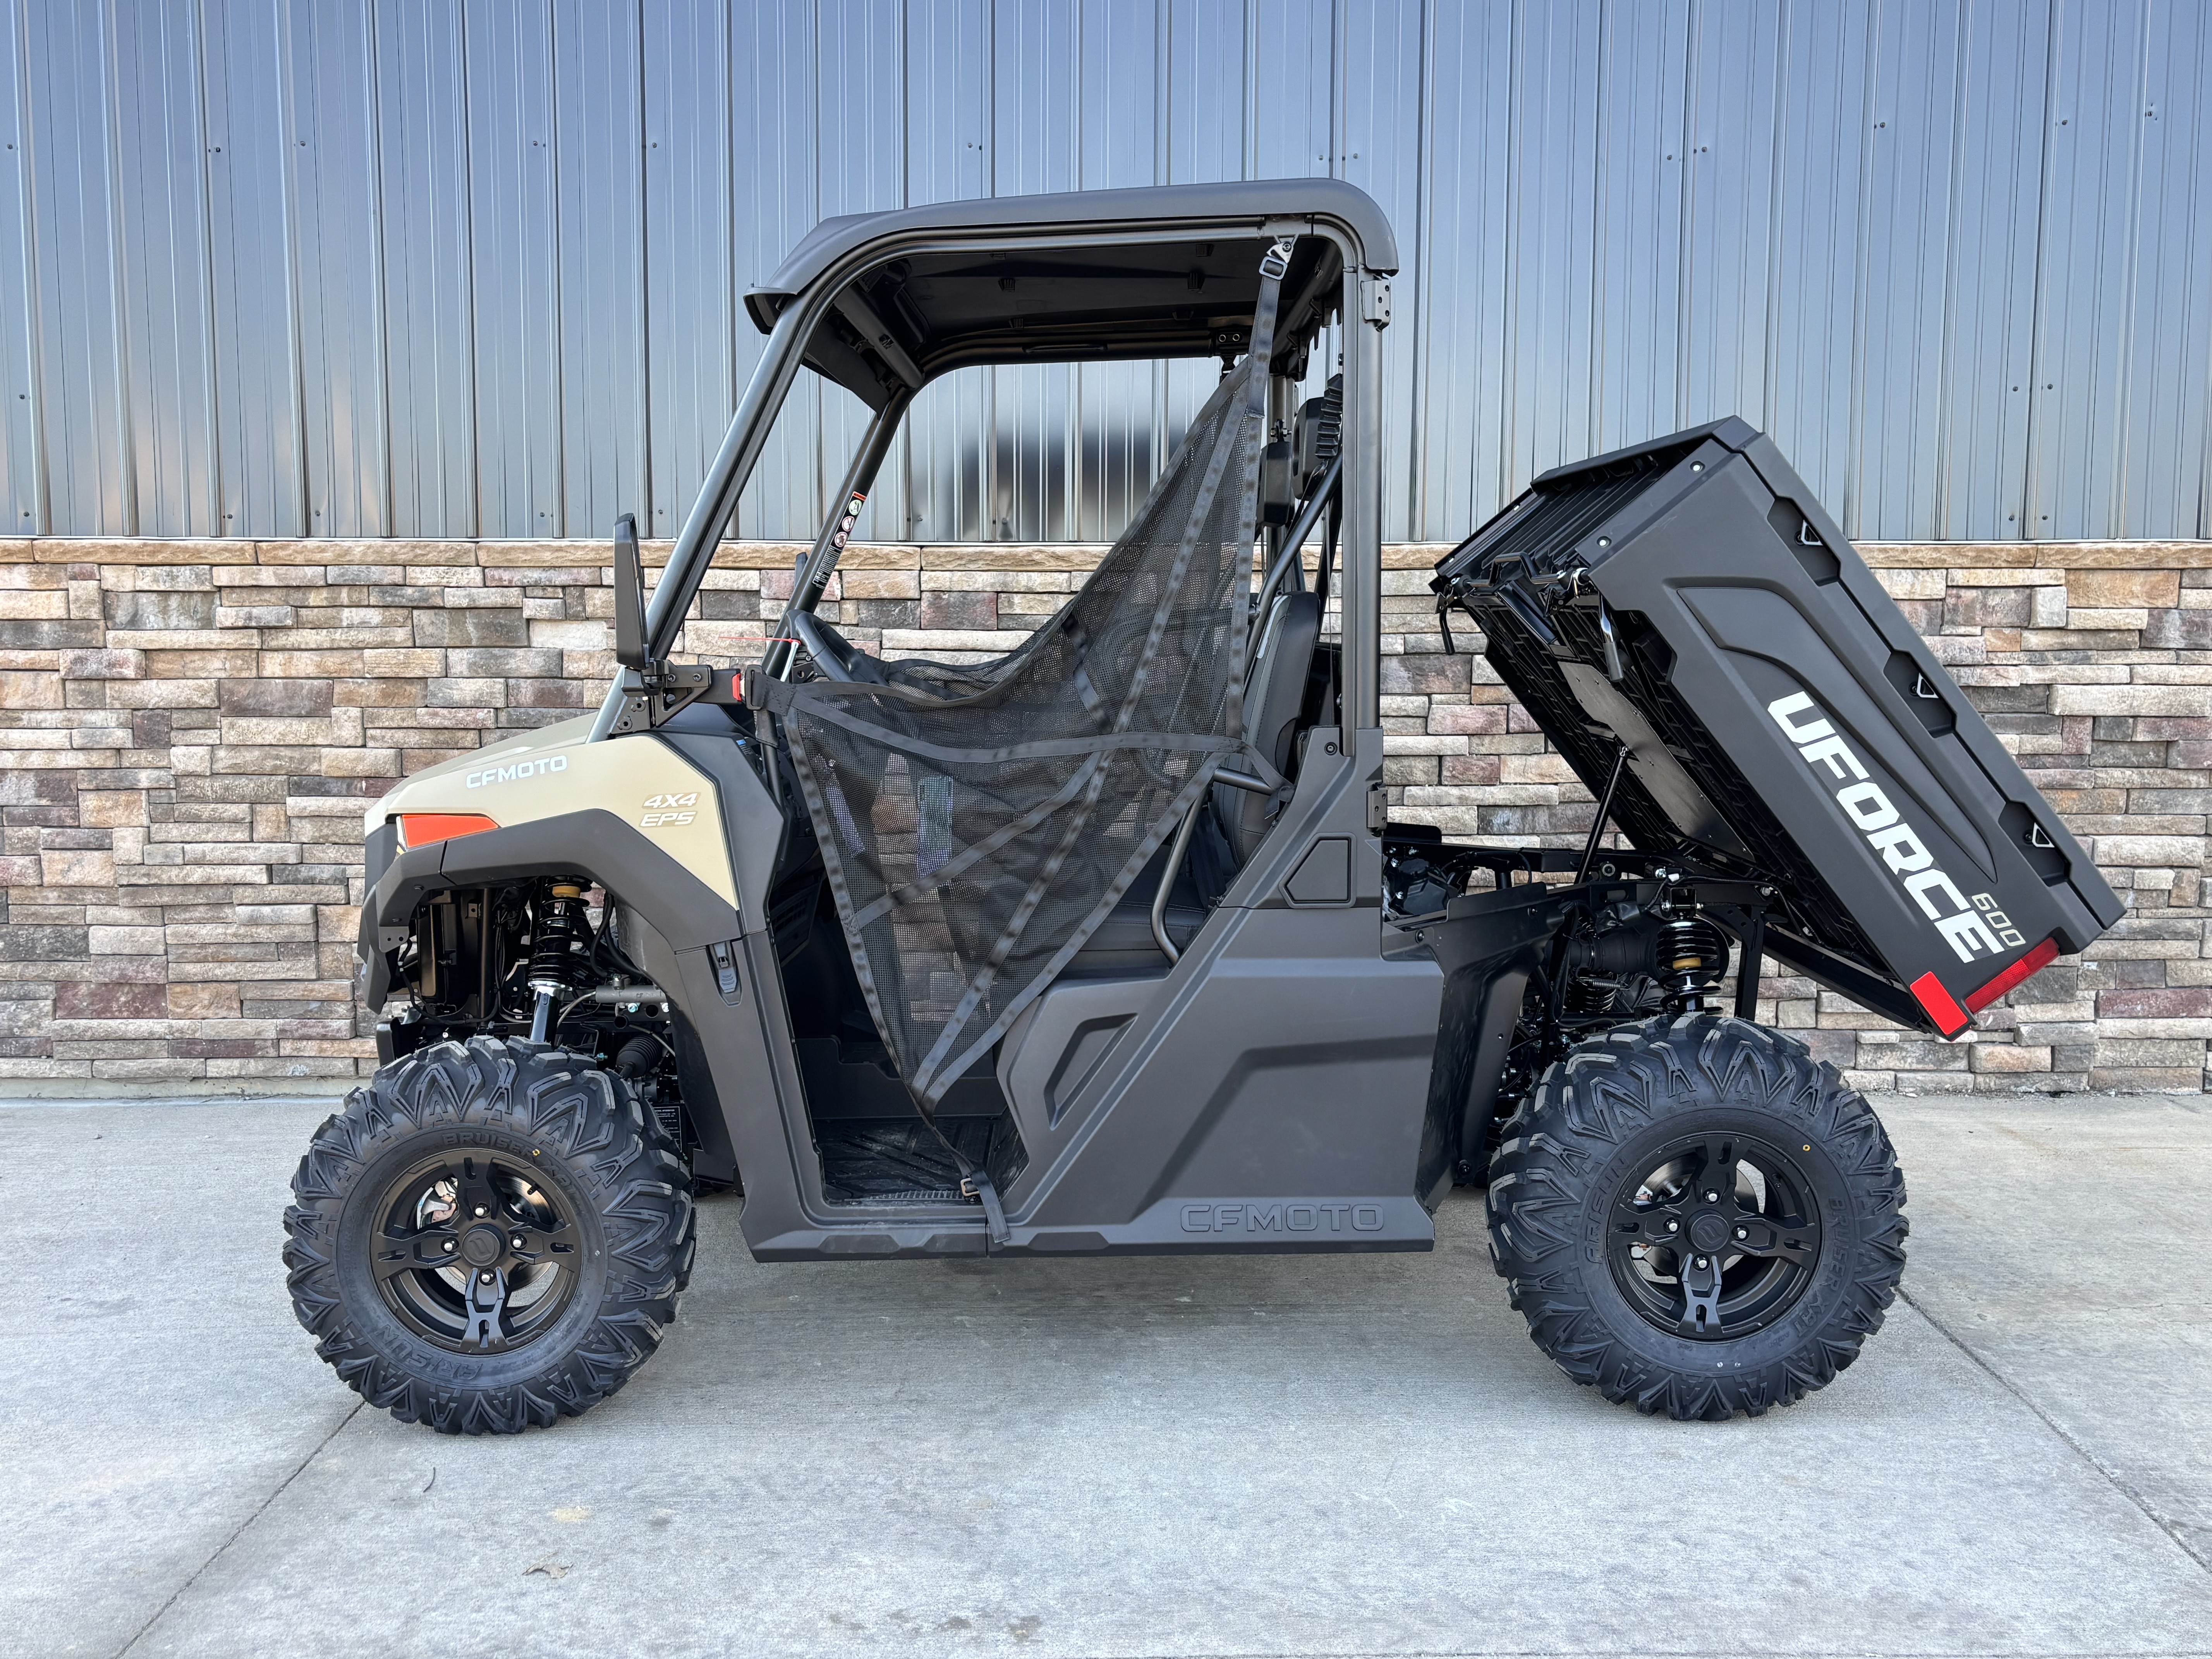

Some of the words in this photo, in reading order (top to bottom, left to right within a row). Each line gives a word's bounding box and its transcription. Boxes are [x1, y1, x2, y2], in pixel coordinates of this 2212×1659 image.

[466, 755, 567, 789] CFMOTO
[640, 812, 696, 827] EPS
[643, 793, 697, 808] 4X4
[1768, 691, 2005, 963] UFORCE
[1971, 893, 2026, 947] 600
[443, 1131, 541, 1161] BRUISER
[1180, 1204, 1384, 1232] CFMOTO
[1586, 1157, 1630, 1262] ARISUN
[1820, 1197, 1848, 1291] BRUISER
[1795, 1291, 1830, 1337] XAT
[374, 1324, 483, 1380] ARISUN
